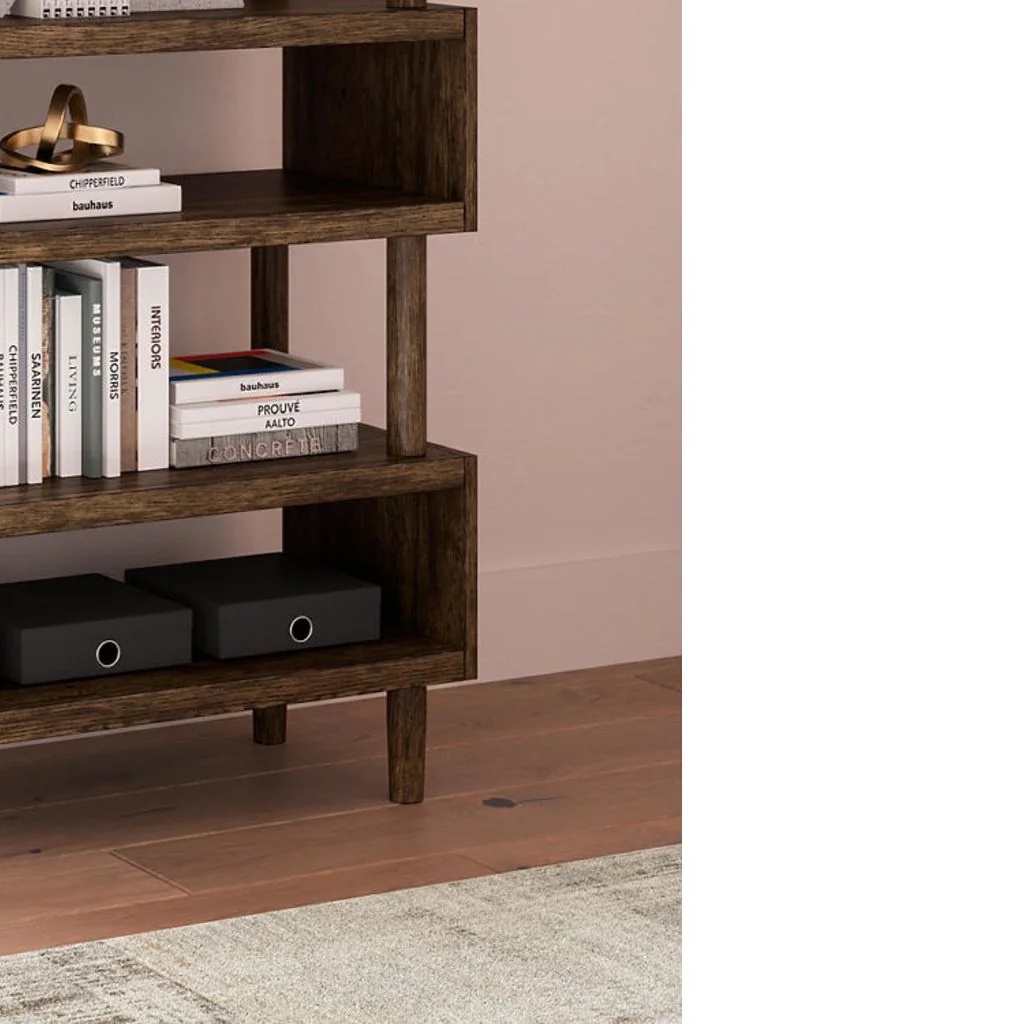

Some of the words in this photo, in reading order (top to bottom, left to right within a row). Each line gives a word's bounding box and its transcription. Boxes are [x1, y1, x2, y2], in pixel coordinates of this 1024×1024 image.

[69, 176, 125, 189] CHIPPERFIELD
[72, 200, 114, 211] bauhaus
[92, 303, 101, 377] MUSEUMS
[150, 306, 162, 370] INTERIORS
[8, 344, 18, 425] CHIPPERFIELD
[31, 352, 41, 419] SAARINEN
[68, 355, 78, 413] LIVING
[109, 351, 119, 400] MORRIS
[240, 381, 280, 392] bauhaus
[257, 400, 301, 416] PROUVÉ
[265, 417, 296, 429] AALTO
[208, 437, 322, 464] CONCRETE
